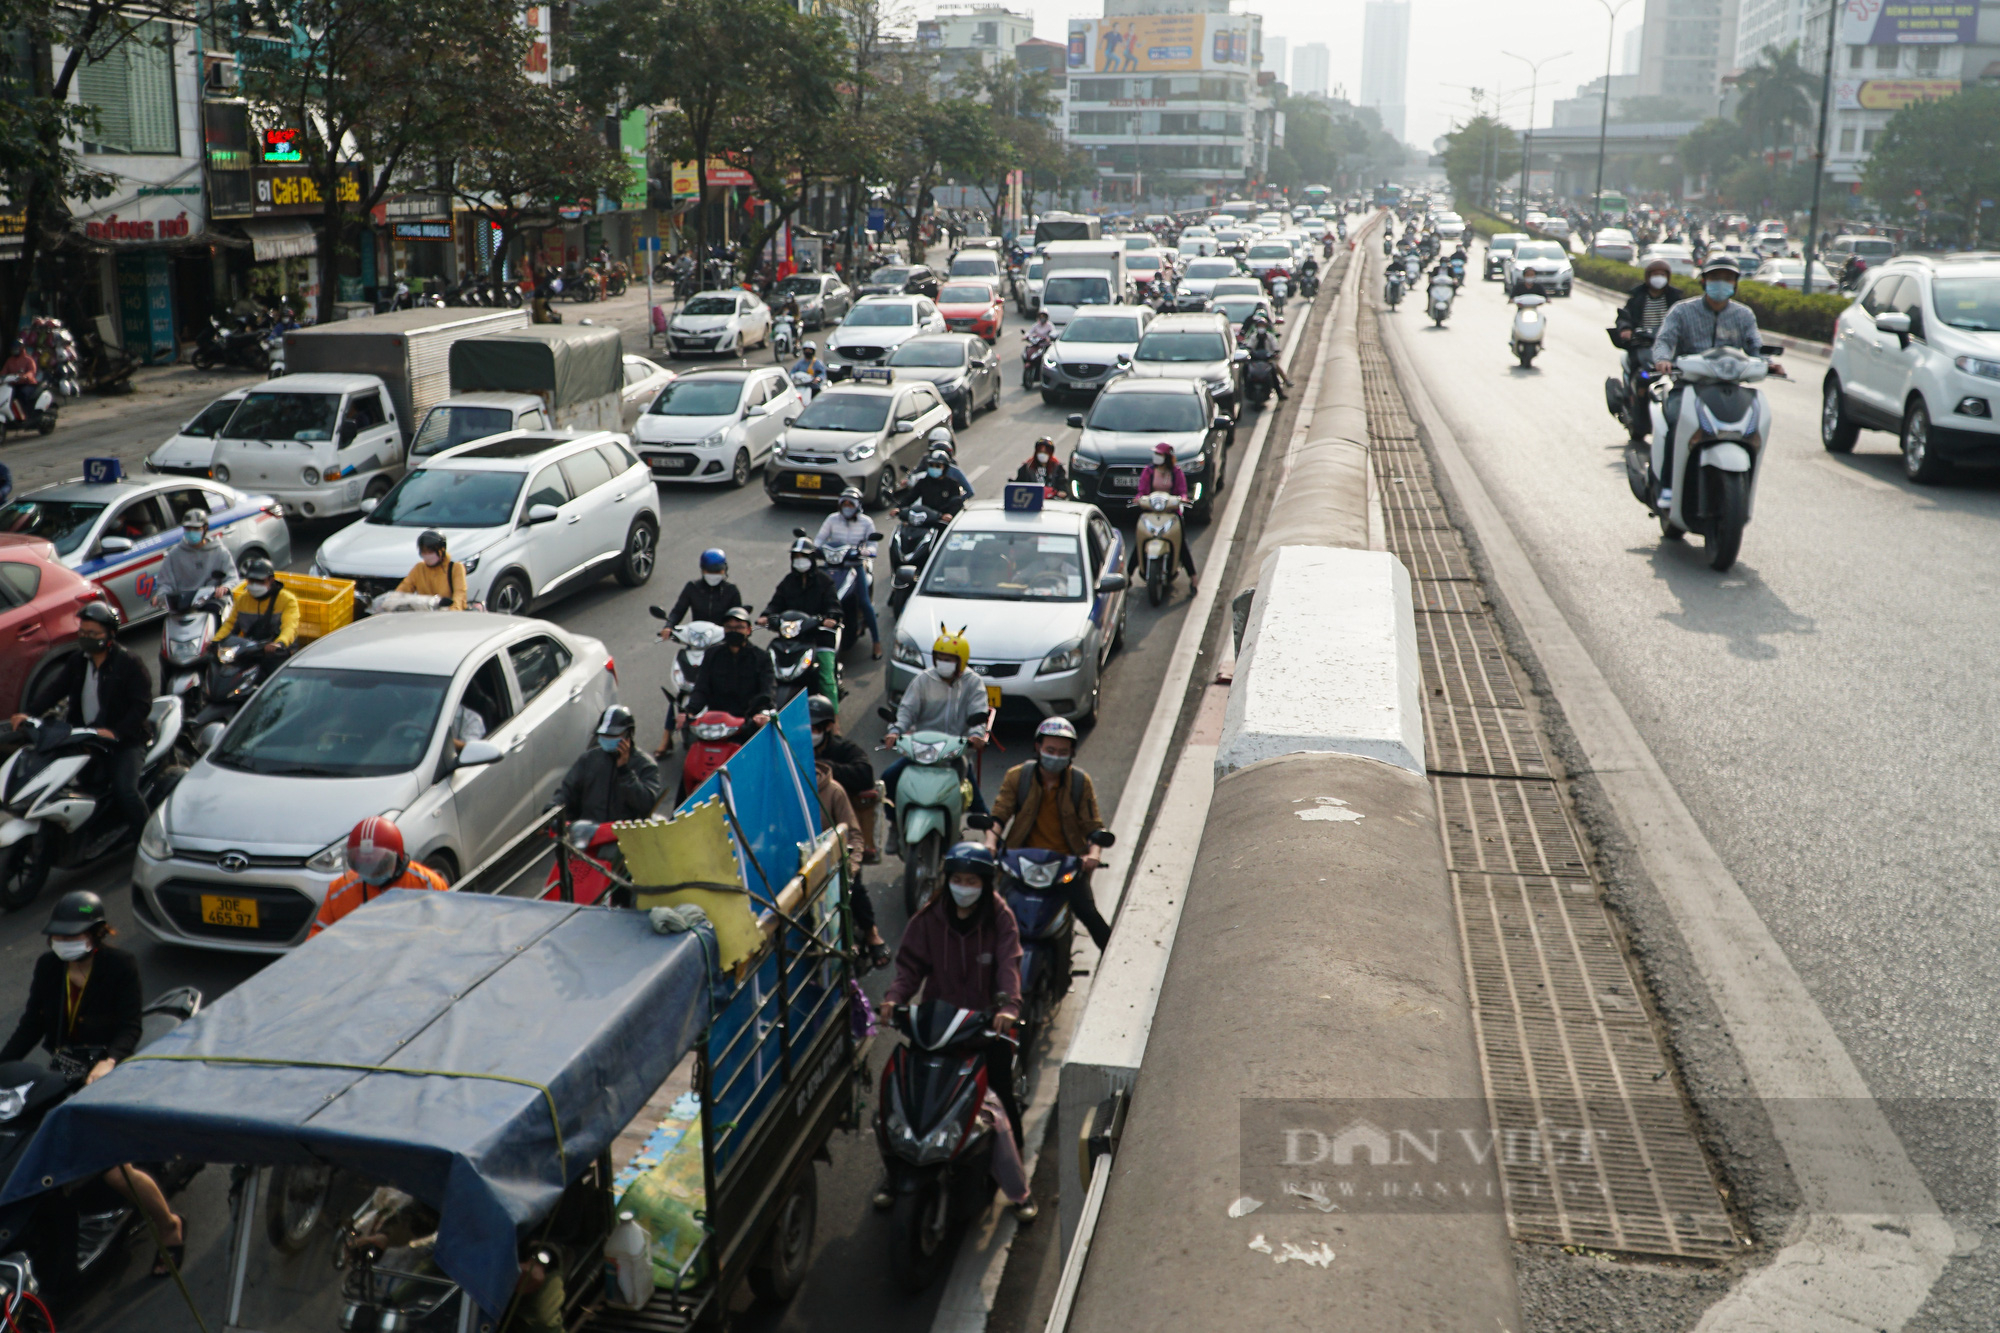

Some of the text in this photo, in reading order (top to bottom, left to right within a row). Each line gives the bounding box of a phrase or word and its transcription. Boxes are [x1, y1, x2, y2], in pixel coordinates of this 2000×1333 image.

[258, 180, 271, 202] 61
[273, 175, 299, 205] Café
[86, 212, 188, 239] ĐỒNG HỒ
[90, 462, 107, 480] G7
[1013, 488, 1033, 509] G7
[135, 572, 154, 599] G7
[217, 898, 240, 912] 30E
[209, 911, 252, 926] 465.97
